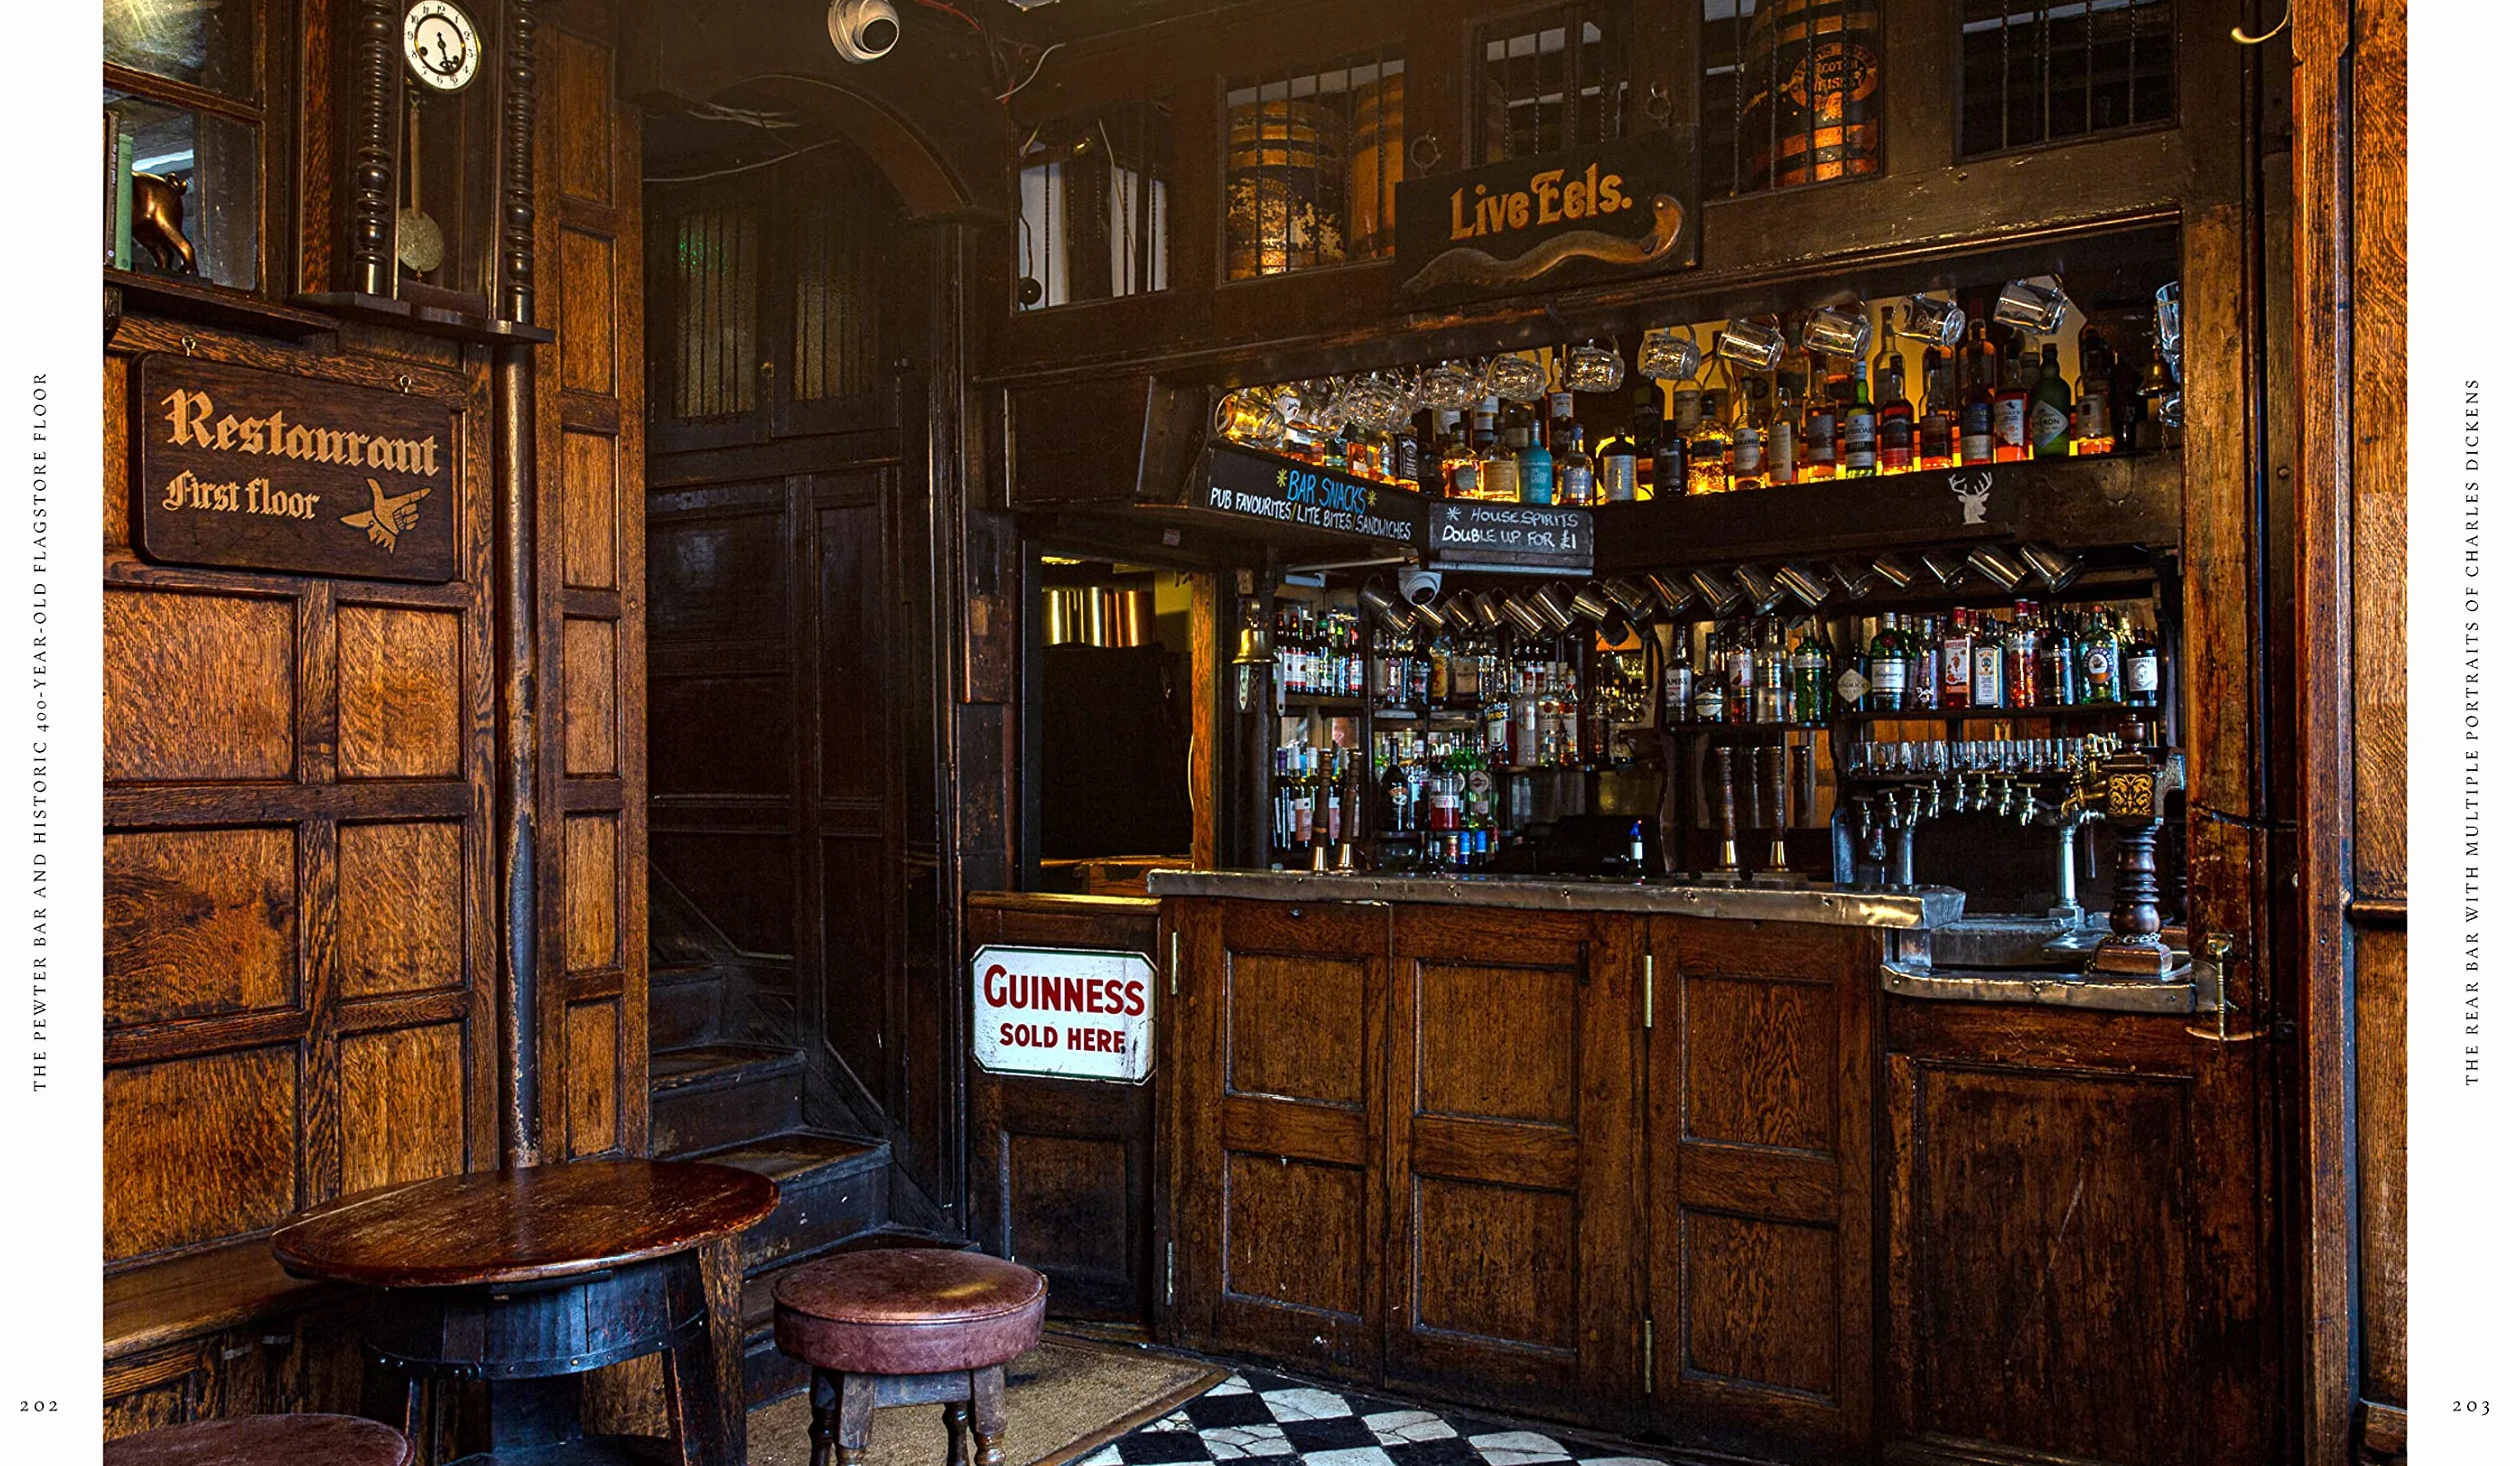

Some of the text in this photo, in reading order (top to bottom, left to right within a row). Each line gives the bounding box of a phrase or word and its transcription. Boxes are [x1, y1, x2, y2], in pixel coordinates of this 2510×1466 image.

[463, 31, 470, 40] 2
[1450, 162, 1633, 241] Live Eels.
[161, 388, 440, 478] Restaurant
[162, 469, 321, 520] First floor
[1210, 487, 1232, 510] PUB
[1286, 469, 1368, 514] BAR SNACKS
[1442, 525, 1497, 543] DOUBLE
[1500, 530, 1522, 544] UP
[1527, 531, 1556, 548] FOR
[1471, 507, 1579, 528] HOUSE SPIRITS
[983, 963, 1146, 1017] GUINNESS
[1000, 1022, 1126, 1054] SOLD HERE
